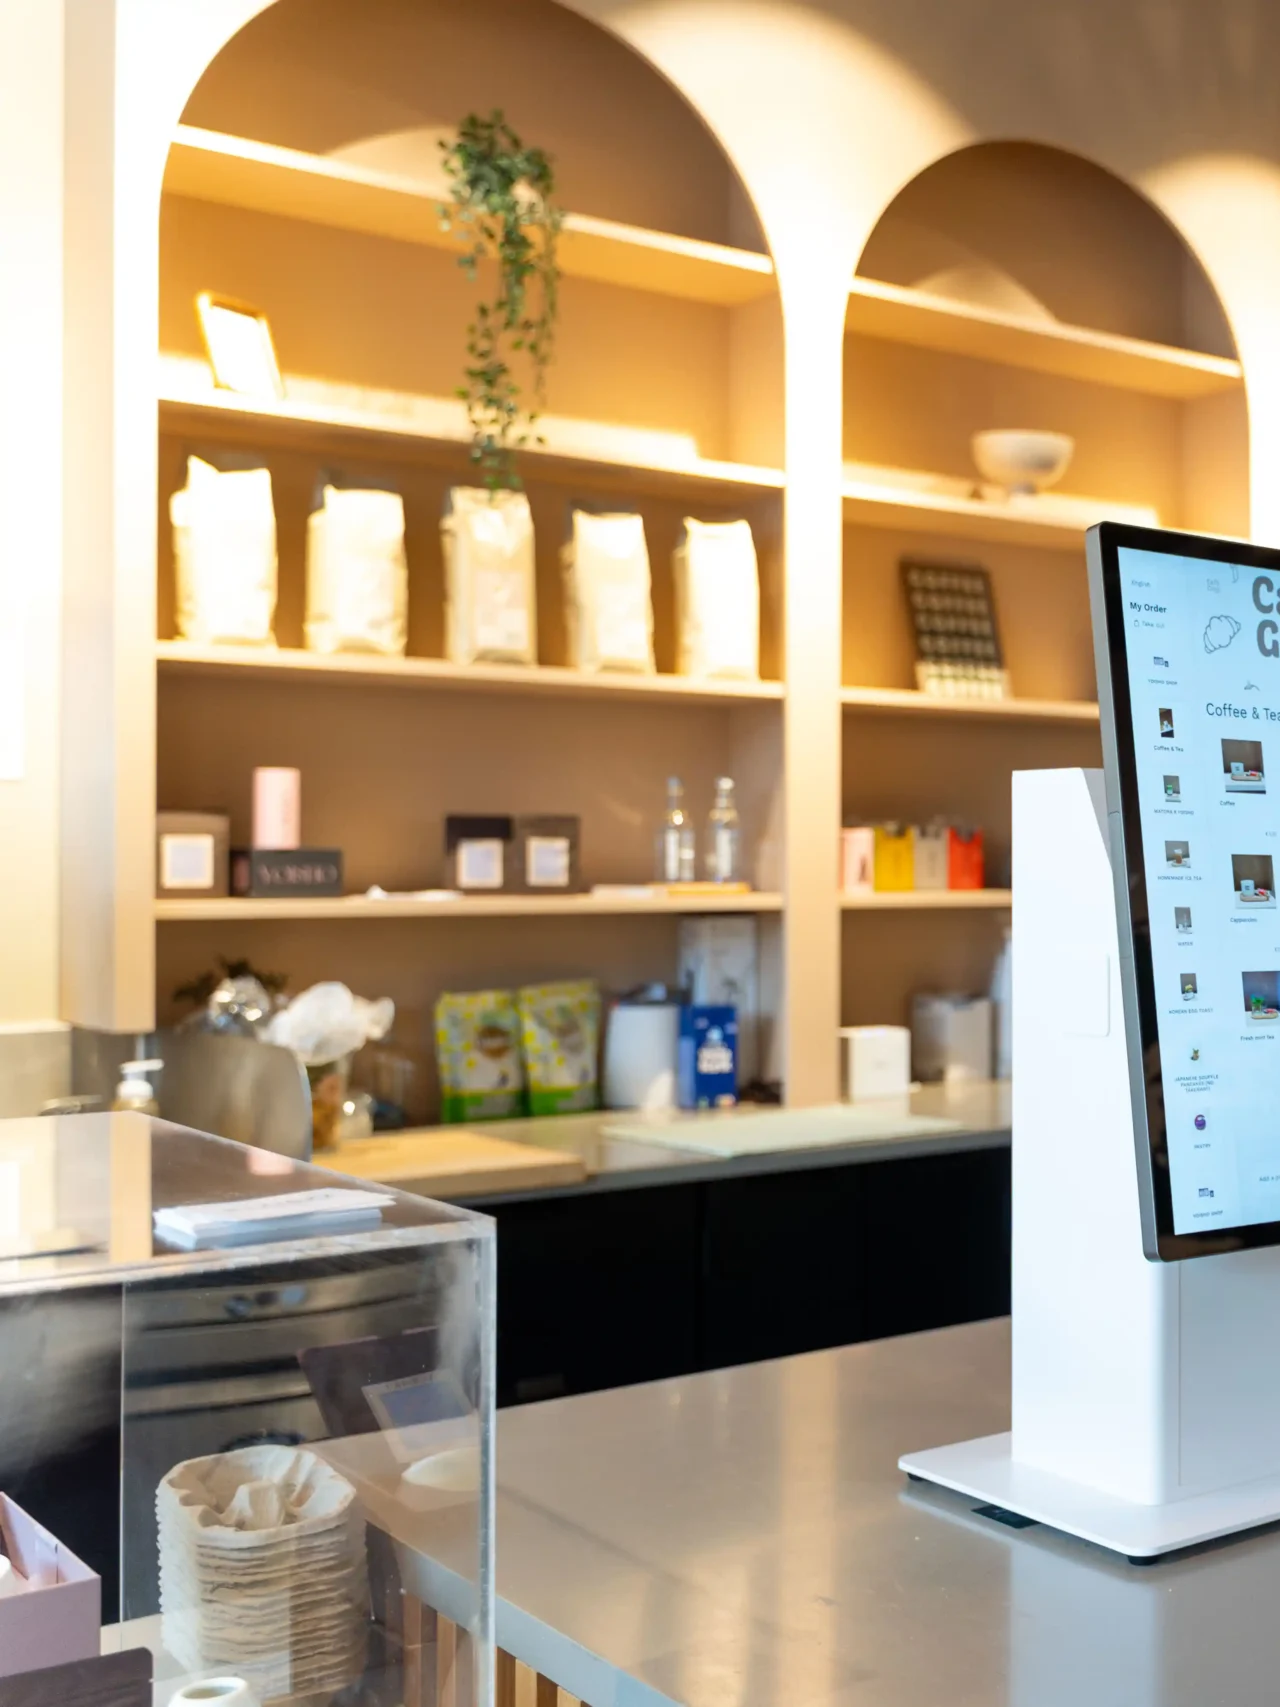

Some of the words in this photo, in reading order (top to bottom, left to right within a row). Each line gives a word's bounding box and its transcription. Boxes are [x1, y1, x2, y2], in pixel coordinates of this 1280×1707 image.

[1130, 602, 1141, 612] My
[1144, 604, 1167, 613] Order
[1206, 702, 1247, 719] Coffee
[1252, 707, 1260, 719] &
